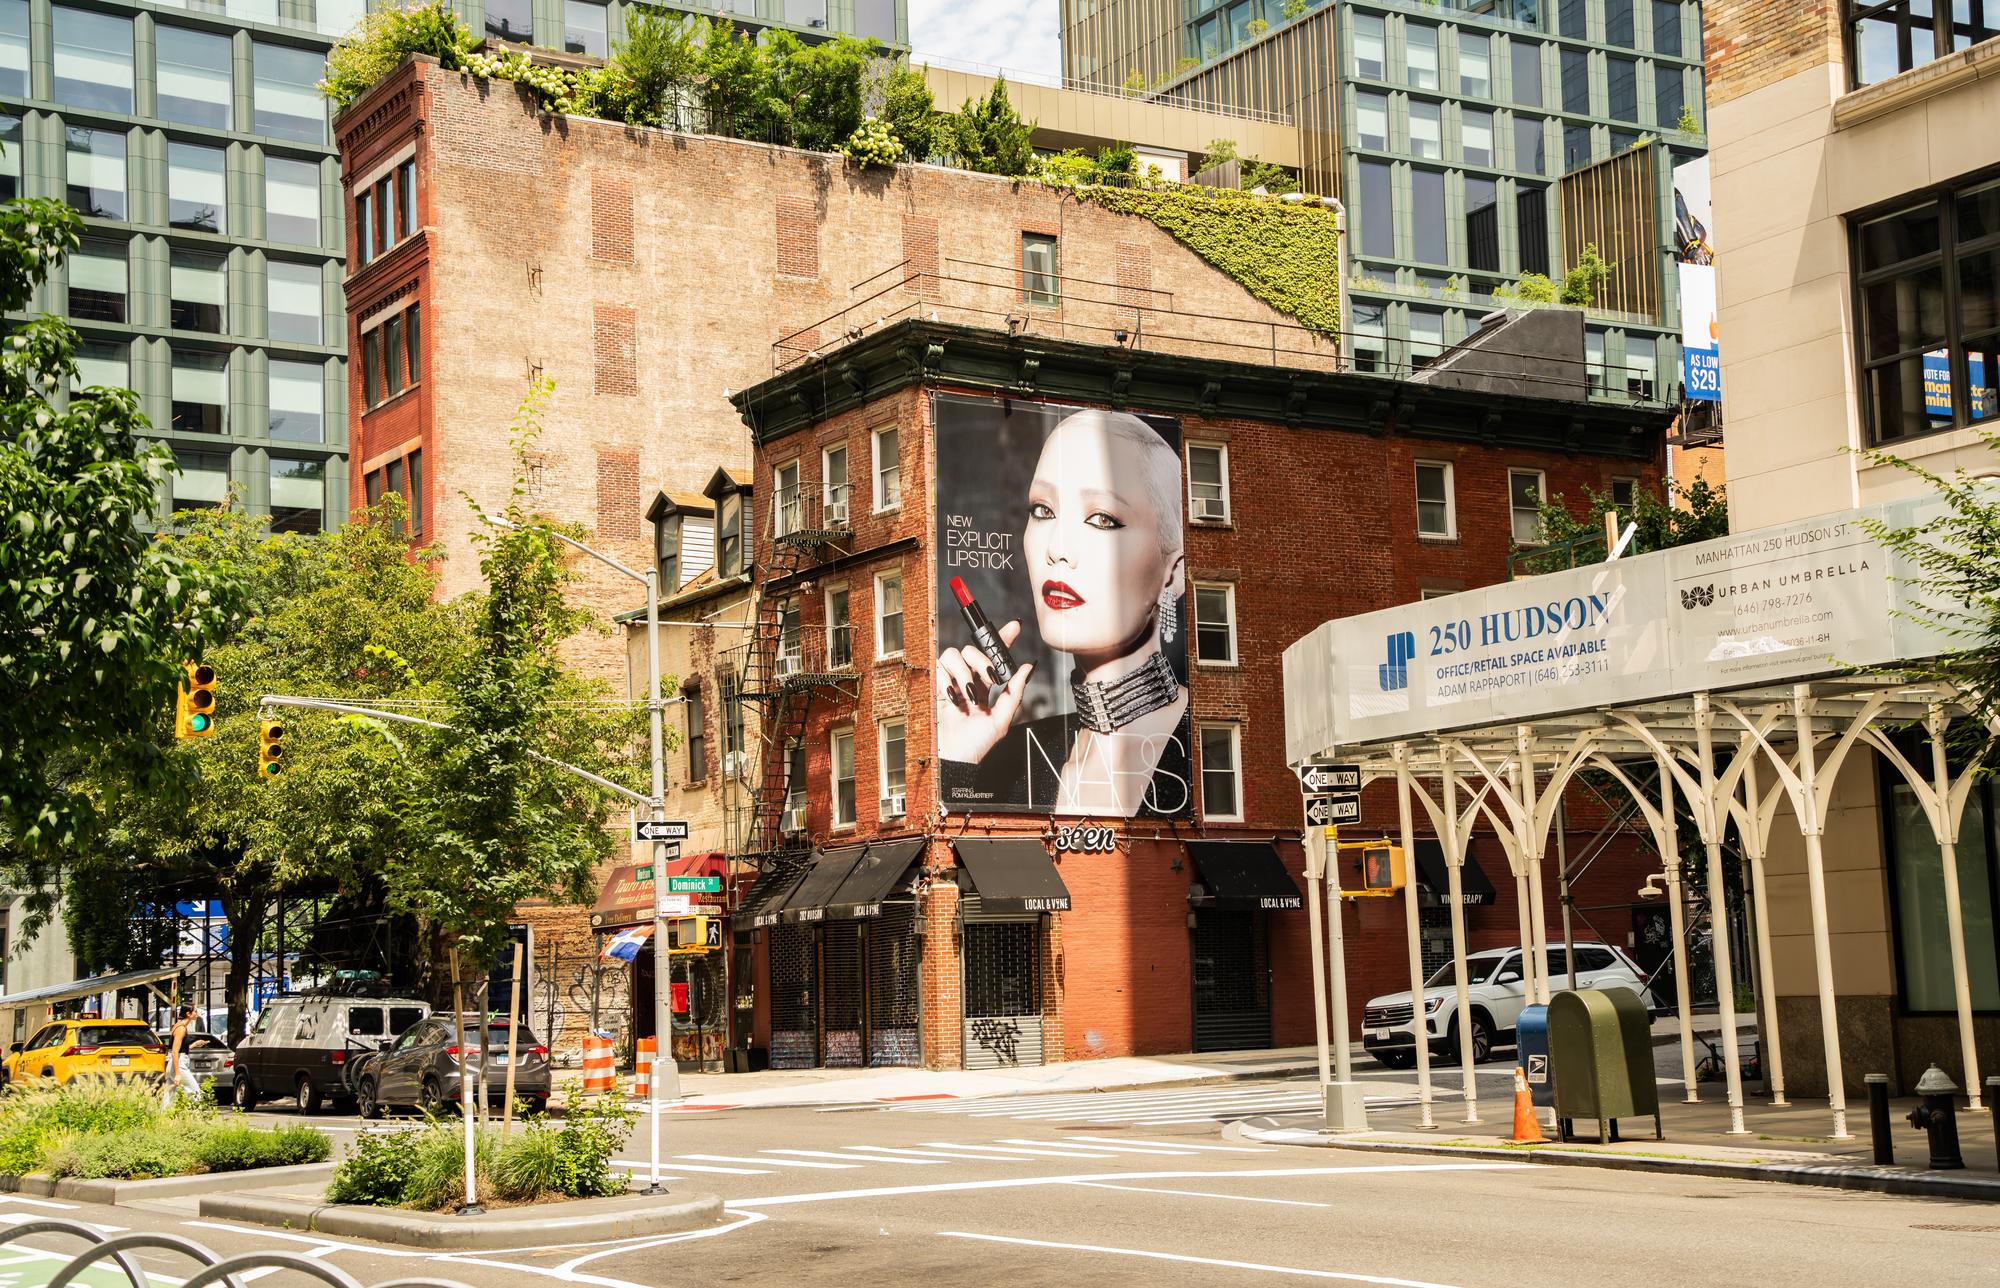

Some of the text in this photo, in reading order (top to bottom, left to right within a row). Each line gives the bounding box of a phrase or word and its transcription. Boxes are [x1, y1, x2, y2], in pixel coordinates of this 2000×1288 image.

[1691, 354, 1718, 369] AS LOW
[1923, 369, 1938, 380] VOTE
[946, 514, 972, 527] NEW
[946, 529, 1013, 550] EXPLICIT
[1696, 524, 1850, 566] MANHATTAN 250 HUDSON ST.
[947, 549, 1014, 570] LIPSTICK
[1719, 561, 1870, 598] URBAN UMBRELLA
[1733, 592, 1812, 618] (646) 798-7276
[1430, 592, 1610, 656] 250 HUDSON
[1717, 610, 1833, 637] www.urbanumbrella.com
[1437, 639, 1607, 679] OFFICE/RETAIL SPACE AVAILABLE
[1438, 681, 1467, 697] ADAM
[1469, 672, 1526, 692] RAPPAPORT
[1534, 666, 1558, 684] (646)
[1562, 659, 1609, 679] 253-3111
[1026, 727, 1188, 813] NARS
[1309, 773, 1356, 785] ONE WAY
[1313, 803, 1355, 818] ONE WAY
[644, 826, 682, 835] ONE WAY
[1056, 826, 1115, 851] seen
[668, 846, 677, 857] WAY
[672, 878, 706, 891] Dominick
[1025, 898, 1045, 910] LOCAL
[1046, 898, 1050, 910] &
[1260, 897, 1279, 908] LOCAL
[1280, 897, 1285, 908] &
[807, 909, 823, 920] HUDSON
[853, 905, 866, 917] LOCAL
[753, 915, 765, 927] LOCAL
